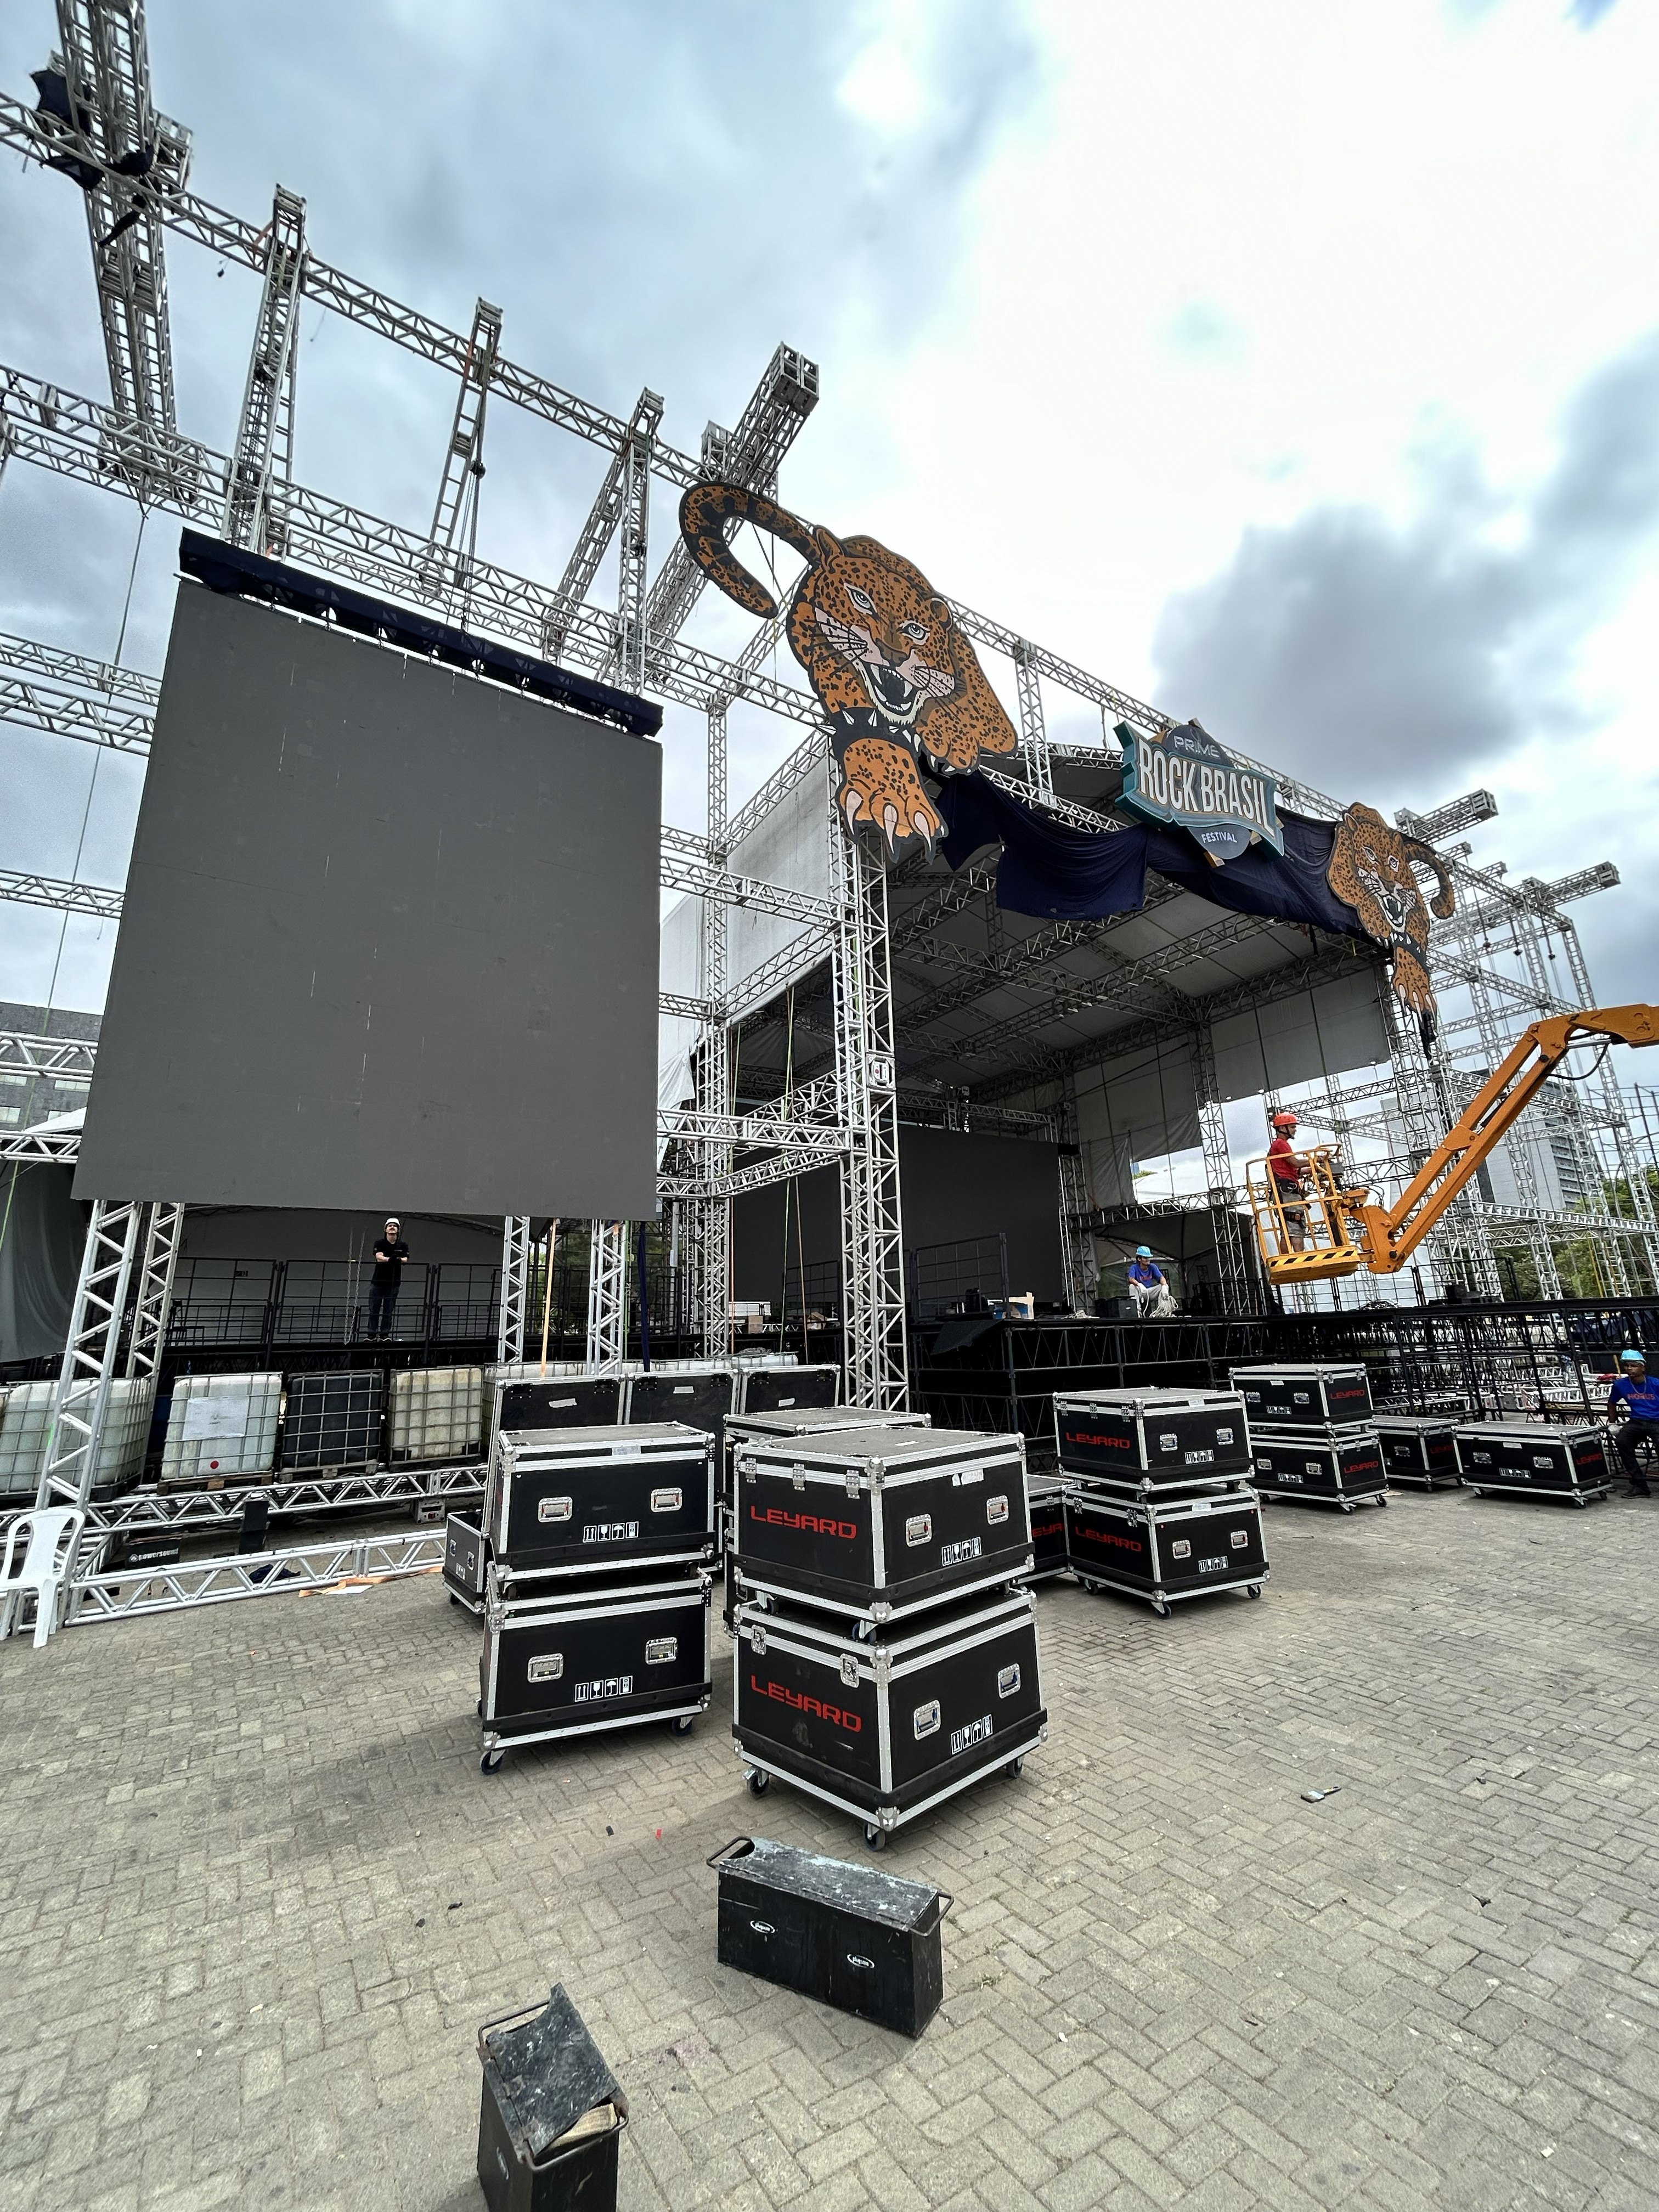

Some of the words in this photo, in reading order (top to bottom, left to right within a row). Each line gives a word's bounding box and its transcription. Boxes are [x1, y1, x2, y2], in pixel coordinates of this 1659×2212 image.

[1174, 735, 1221, 758] PRIME
[1138, 738, 1199, 812] ROCK
[1200, 765, 1275, 838] BRASIL
[1201, 832, 1238, 844] FESTIVAL
[1330, 1390, 1365, 1400] LEYARD
[1065, 1432, 1131, 1449] LEYARD
[1344, 1460, 1379, 1474] LEYARD
[750, 1505, 857, 1539] LEYARD
[1032, 1523, 1064, 1537] EYA
[1075, 1526, 1142, 1552] LEYARD
[751, 1674, 862, 1733] LEYARD
